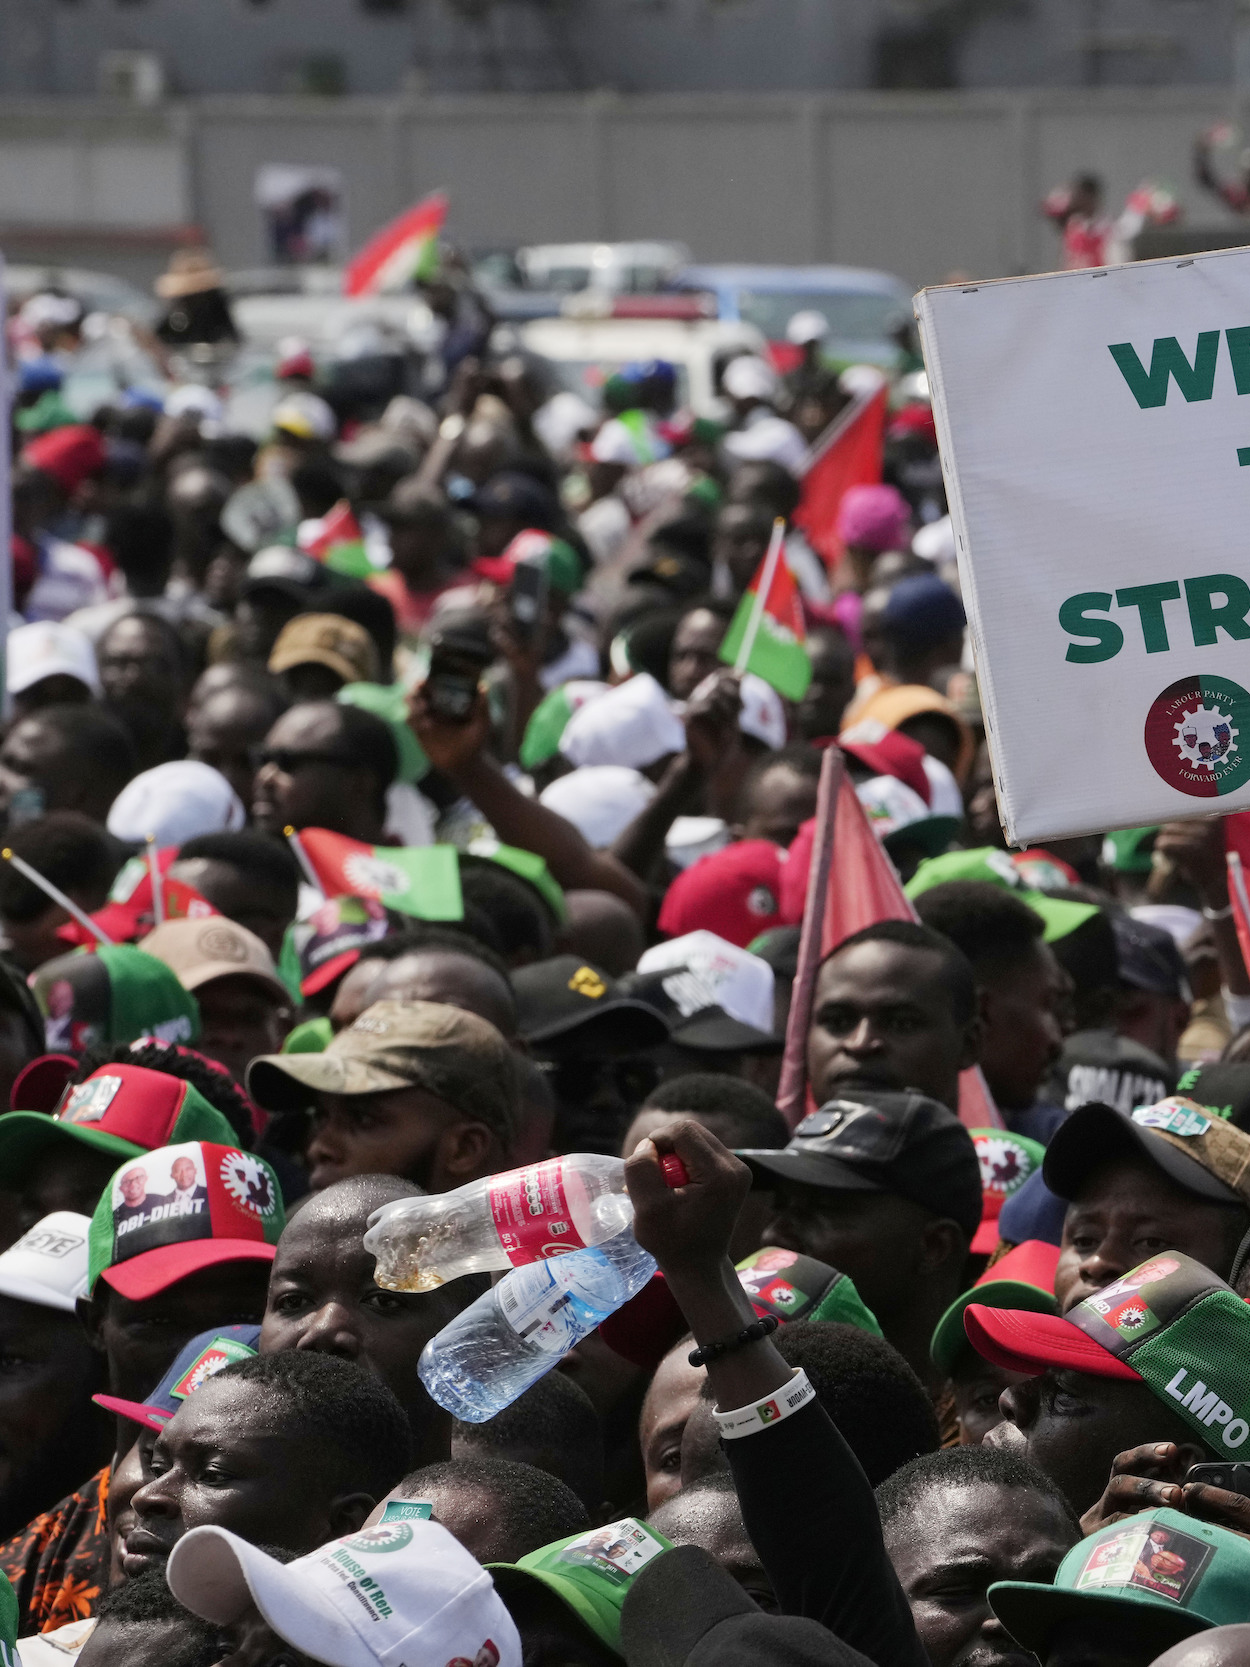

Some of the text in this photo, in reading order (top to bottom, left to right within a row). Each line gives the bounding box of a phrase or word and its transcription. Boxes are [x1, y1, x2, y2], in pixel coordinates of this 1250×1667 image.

[1165, 690, 1237, 716] LABOUR PARTY
[1178, 755, 1243, 782] FORWARD EVER
[117, 1198, 205, 1237] OBI-DIENT
[1165, 1367, 1250, 1449] LMPO
[400, 1505, 422, 1517] VOTE
[330, 1548, 366, 1578] House
[368, 1590, 394, 1620] Rep.
[346, 1580, 381, 1622] Constituency
